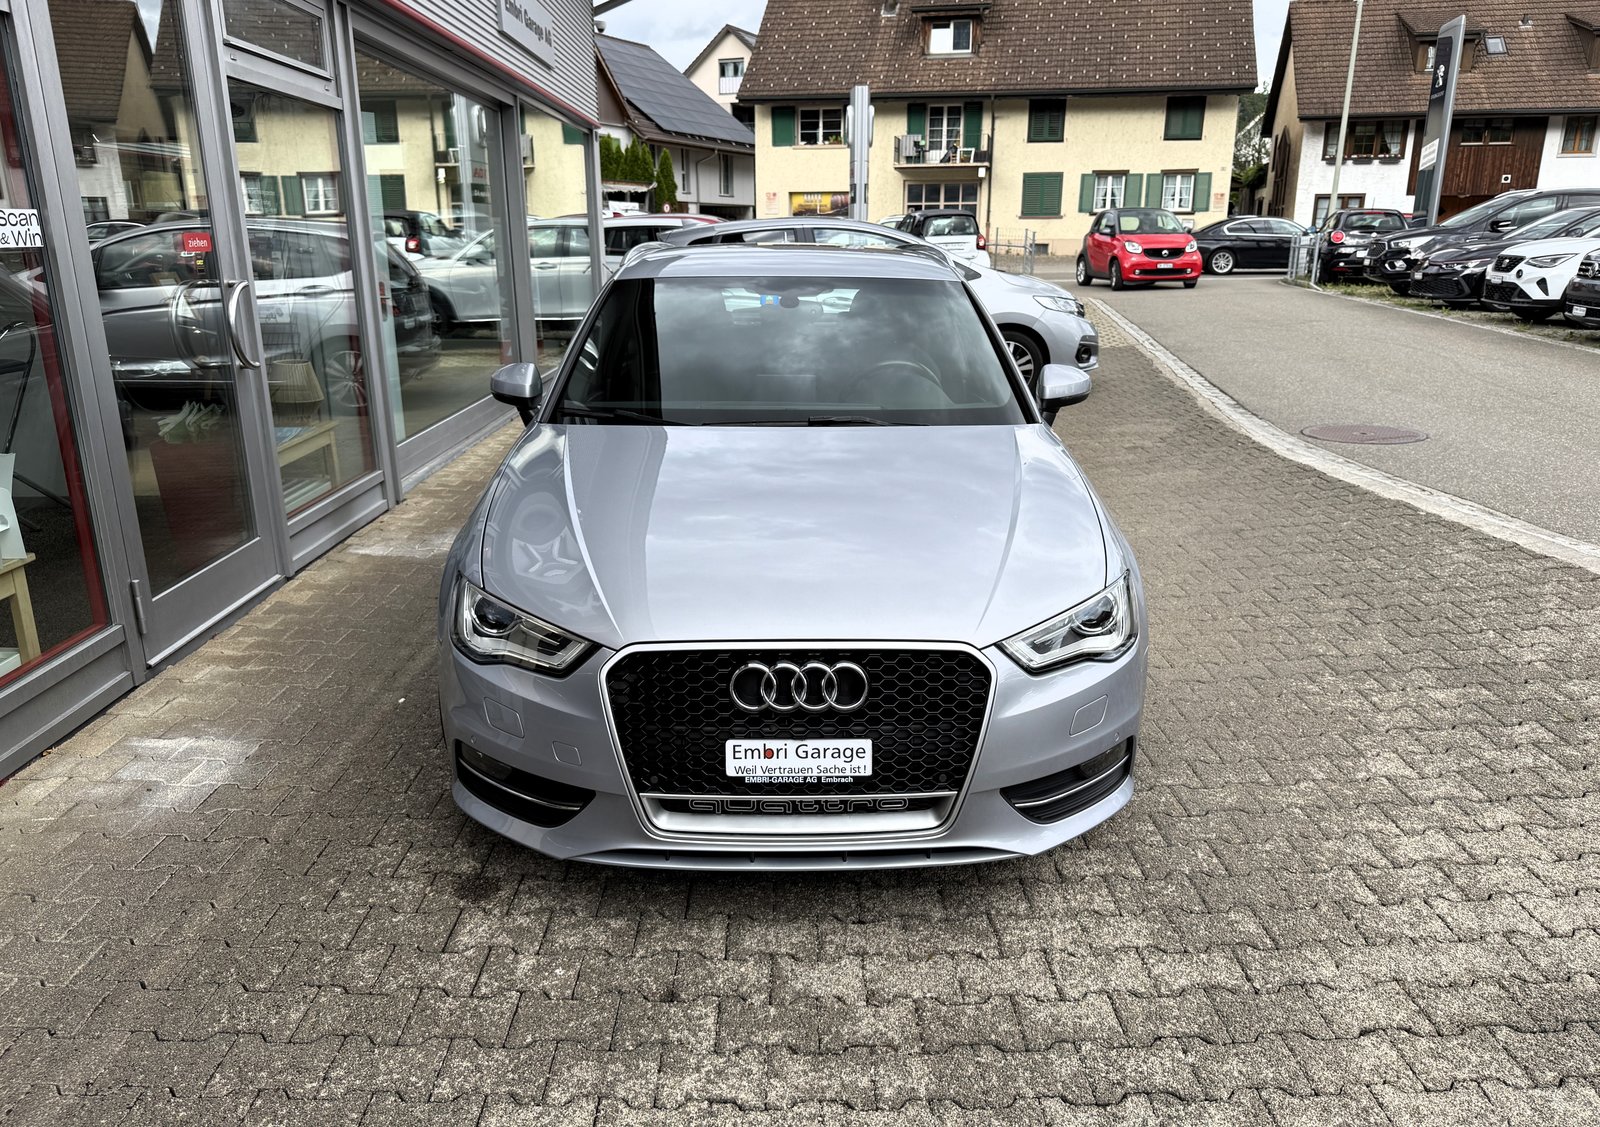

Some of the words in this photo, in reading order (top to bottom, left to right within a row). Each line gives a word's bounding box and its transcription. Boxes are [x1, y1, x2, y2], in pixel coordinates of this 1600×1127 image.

[0, 209, 40, 227] Scan
[0, 232, 10, 245] &
[10, 228, 44, 246] Win
[188, 237, 207, 247] ziehen
[732, 743, 788, 760] Embri
[795, 744, 866, 763] Garage
[734, 765, 757, 775] Weil
[760, 765, 813, 775] Vertrauen
[816, 764, 847, 775] Sache
[688, 797, 909, 814] quattro
